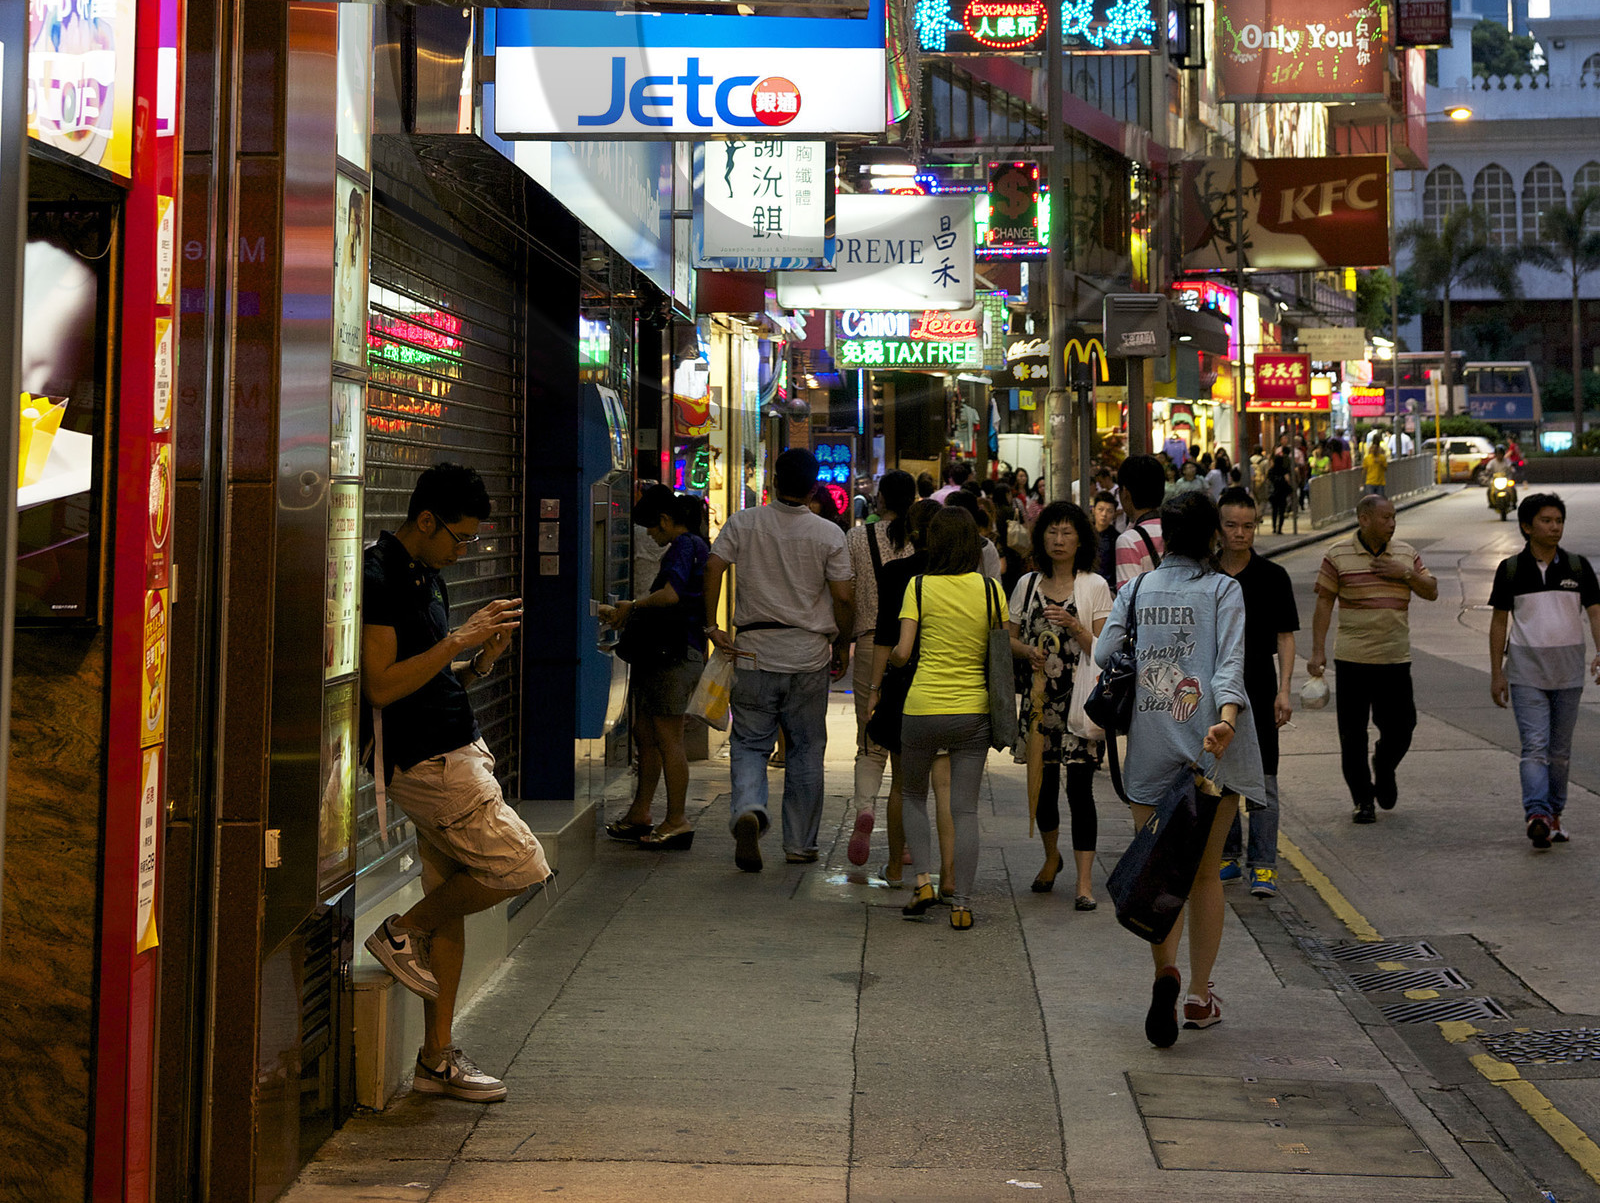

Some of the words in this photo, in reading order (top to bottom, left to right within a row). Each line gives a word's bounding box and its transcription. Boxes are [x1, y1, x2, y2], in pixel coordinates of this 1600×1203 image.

[972, 4, 1040, 16] EXCHANGE
[1242, 24, 1300, 53] Only
[1305, 23, 1354, 48] You
[1278, 174, 1379, 224] KFC
[842, 309, 910, 337] Canon
[910, 310, 977, 340] Leica
[885, 341, 924, 364] TAX
[926, 341, 978, 364] FREE
[1030, 364, 1048, 378] 24
